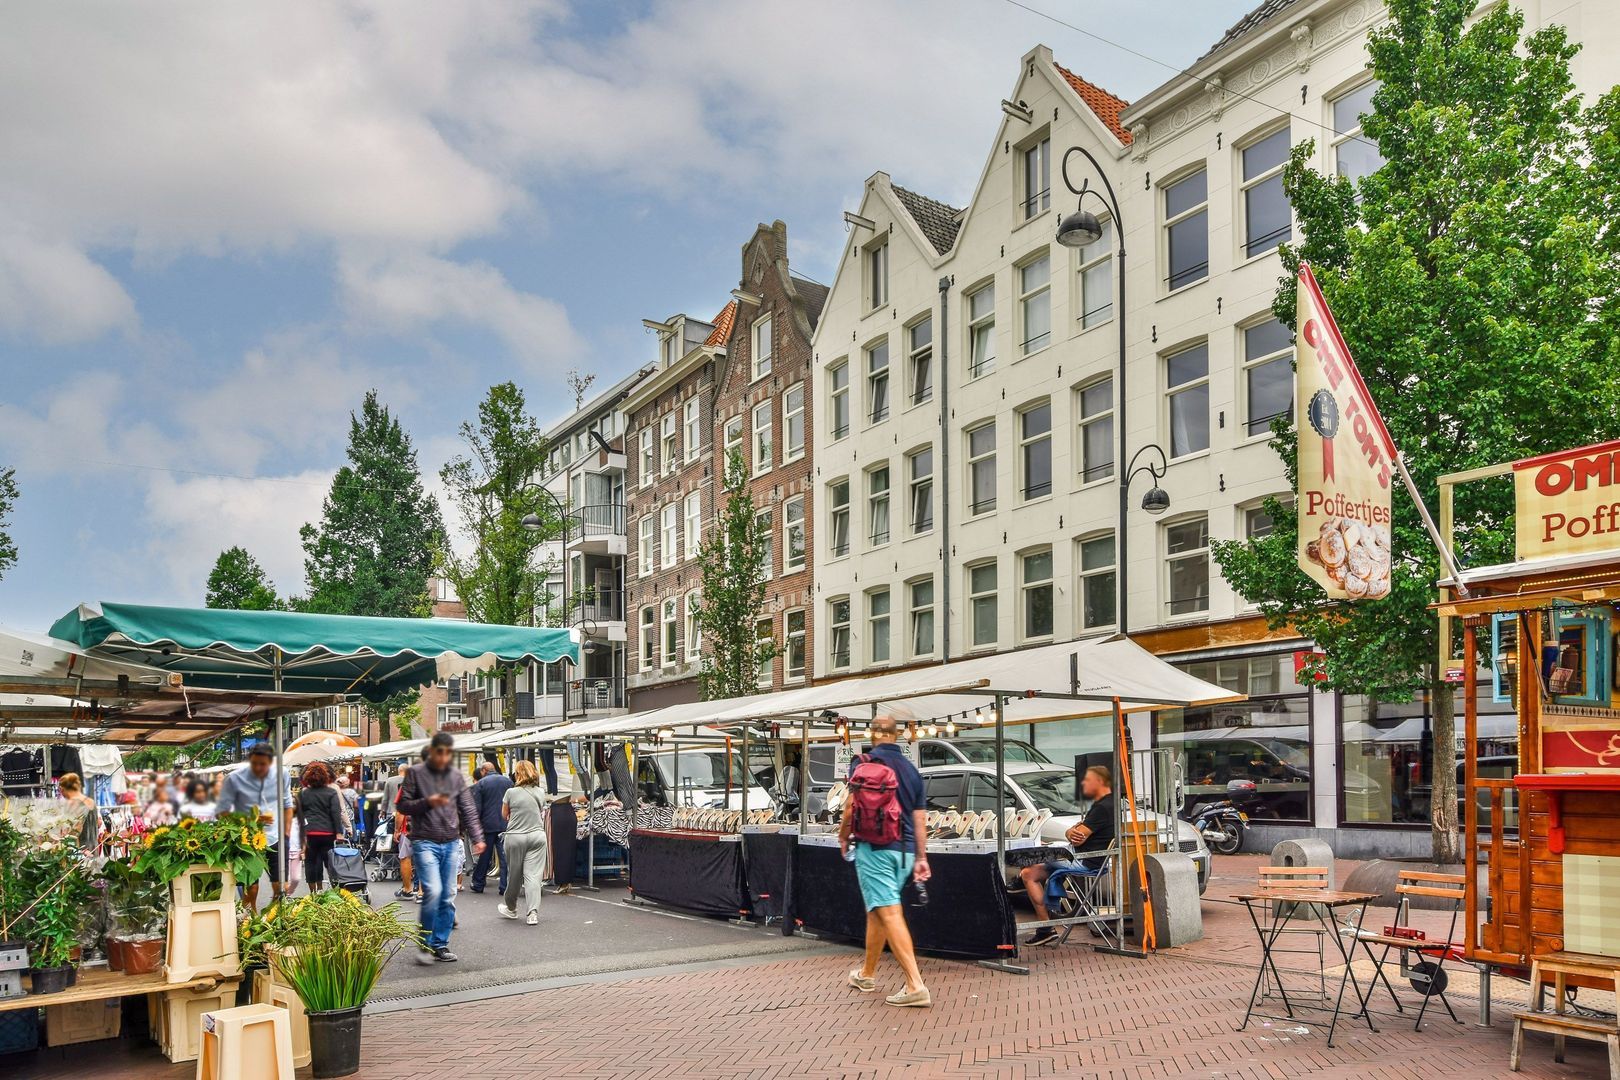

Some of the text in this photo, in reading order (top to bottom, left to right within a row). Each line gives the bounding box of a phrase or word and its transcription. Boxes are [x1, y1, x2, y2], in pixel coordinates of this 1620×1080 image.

[1303, 318, 1393, 489] OME TOM'S
[1306, 490, 1390, 528] Poffertjes
